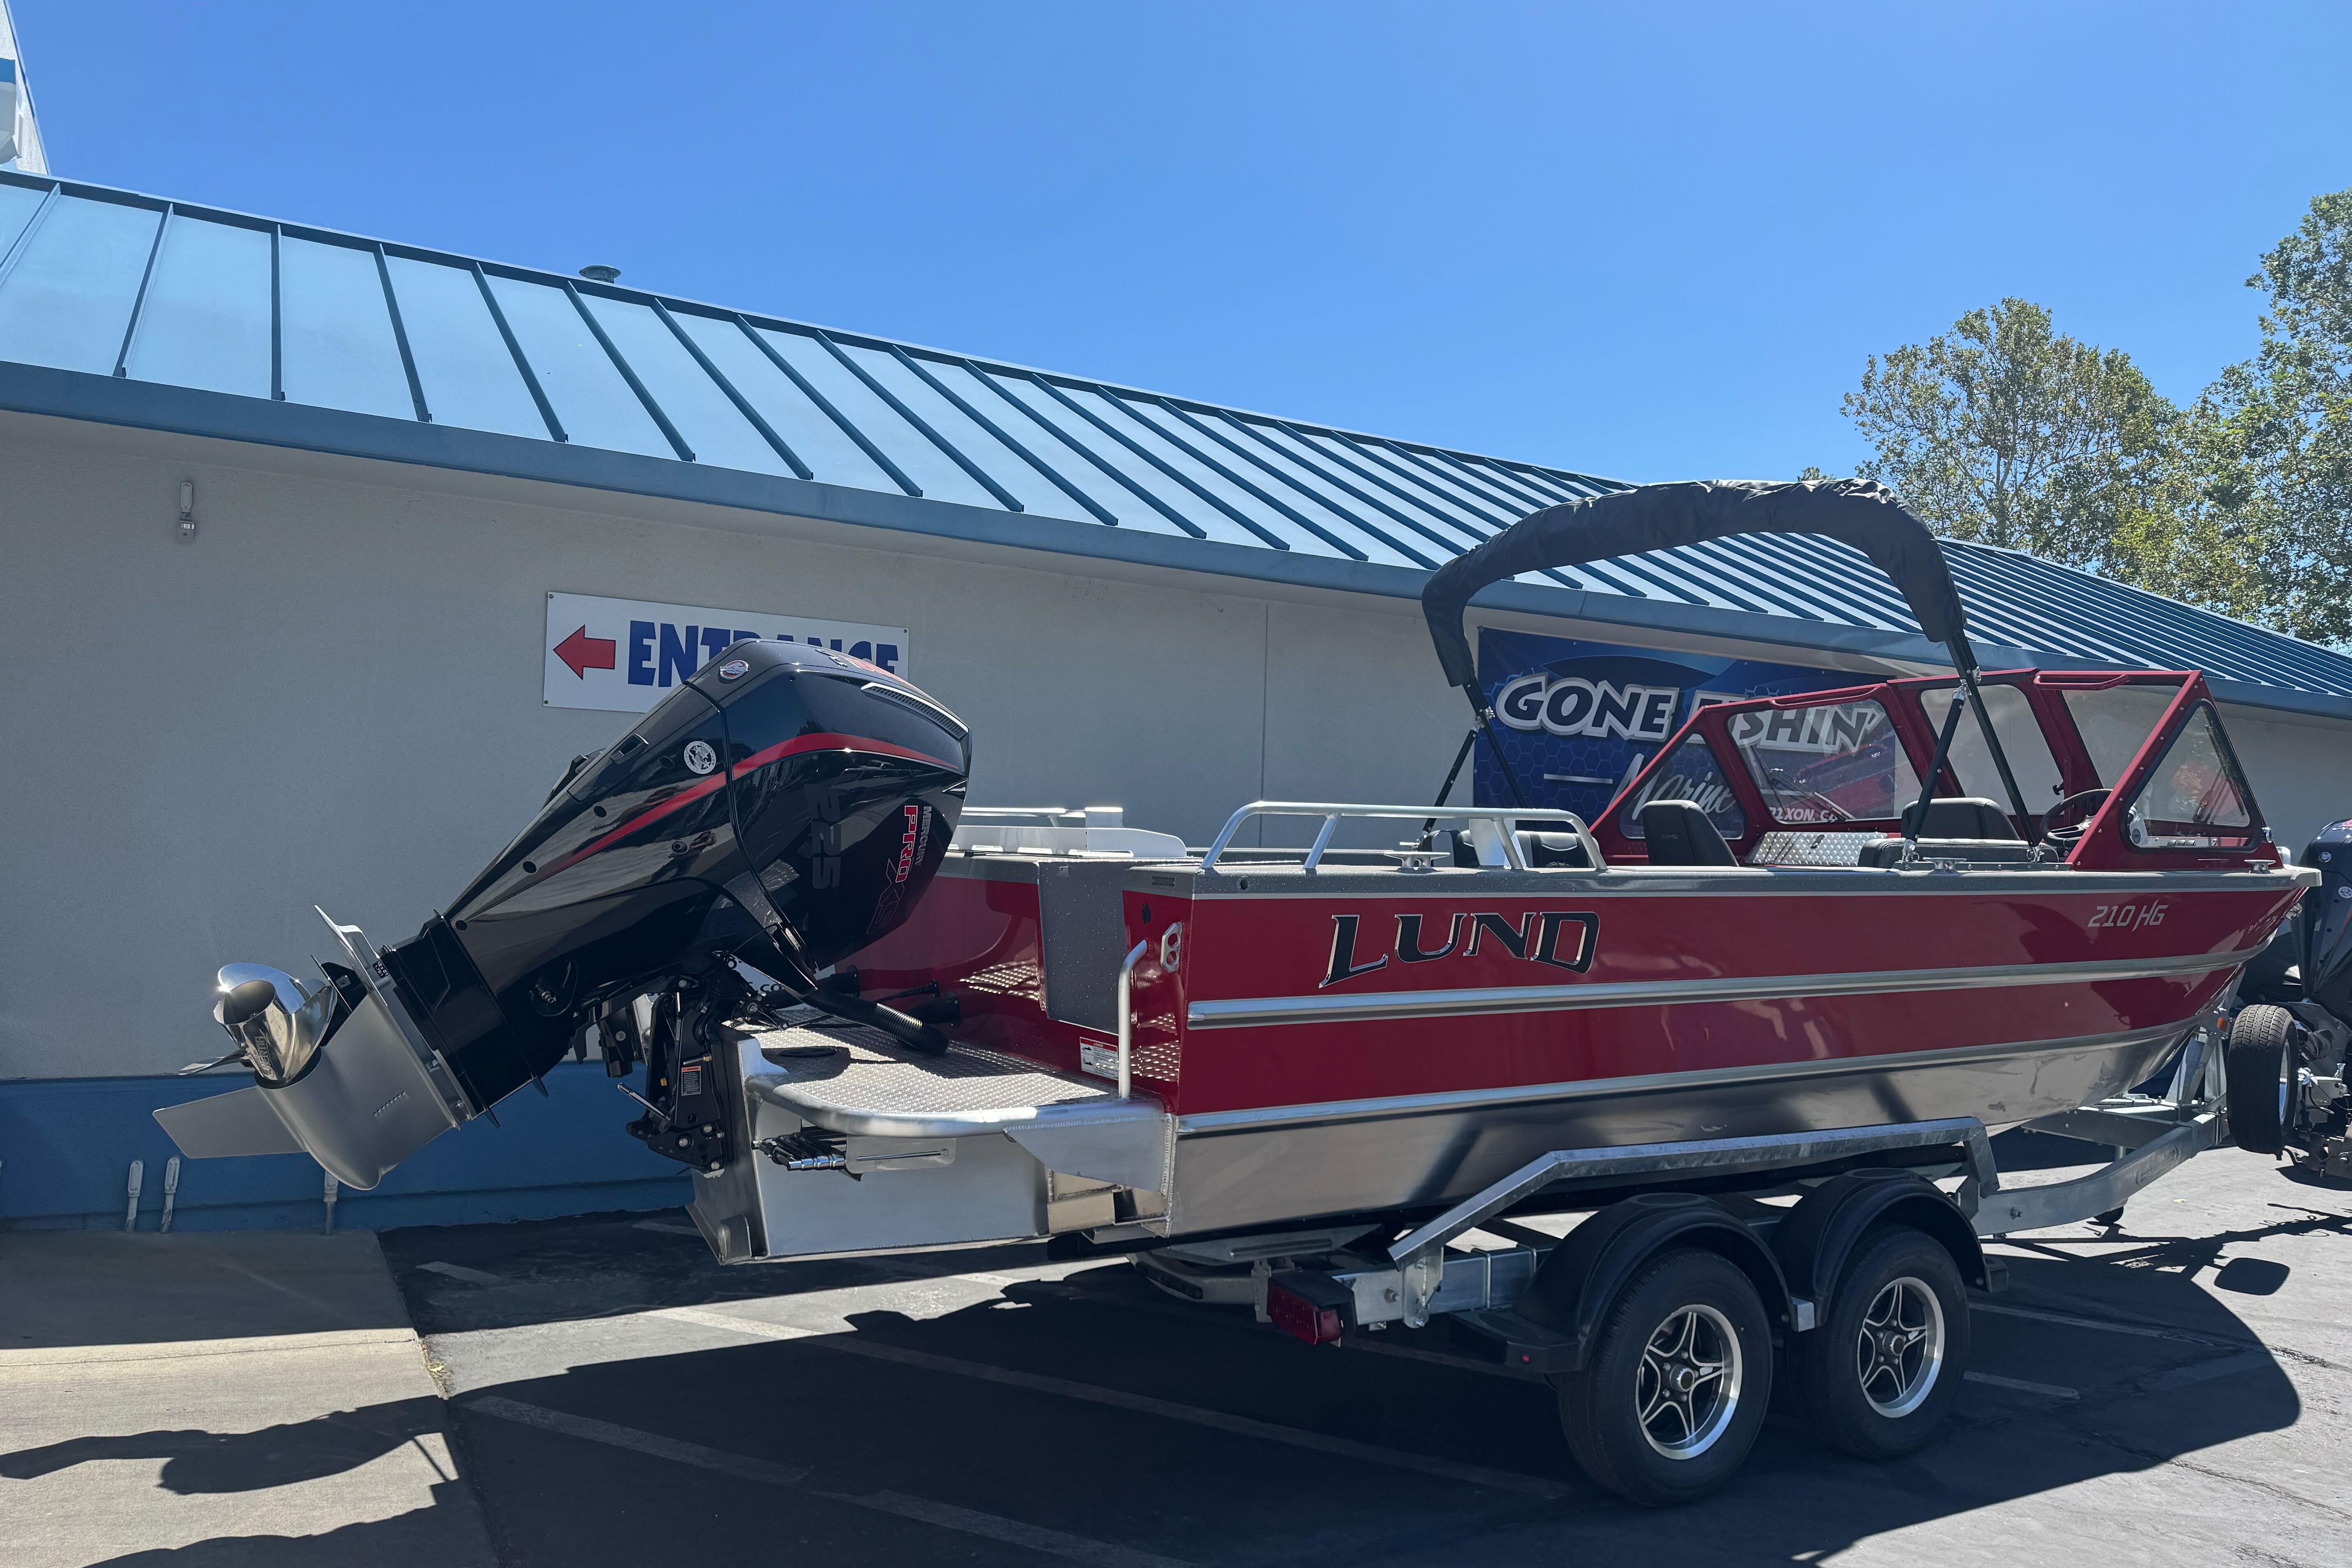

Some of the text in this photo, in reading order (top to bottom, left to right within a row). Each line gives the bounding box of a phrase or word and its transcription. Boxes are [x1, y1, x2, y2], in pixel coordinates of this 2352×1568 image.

[628, 620, 899, 687] ENTE
[1502, 681, 1878, 749] GONE SHIN'
[1608, 753, 1736, 821] Marine
[804, 784, 842, 889] 225
[866, 805, 918, 934] PRO XS
[915, 806, 932, 866] MERCURY
[2087, 899, 2169, 932] 210 HG
[1318, 912, 1600, 989] LUND
